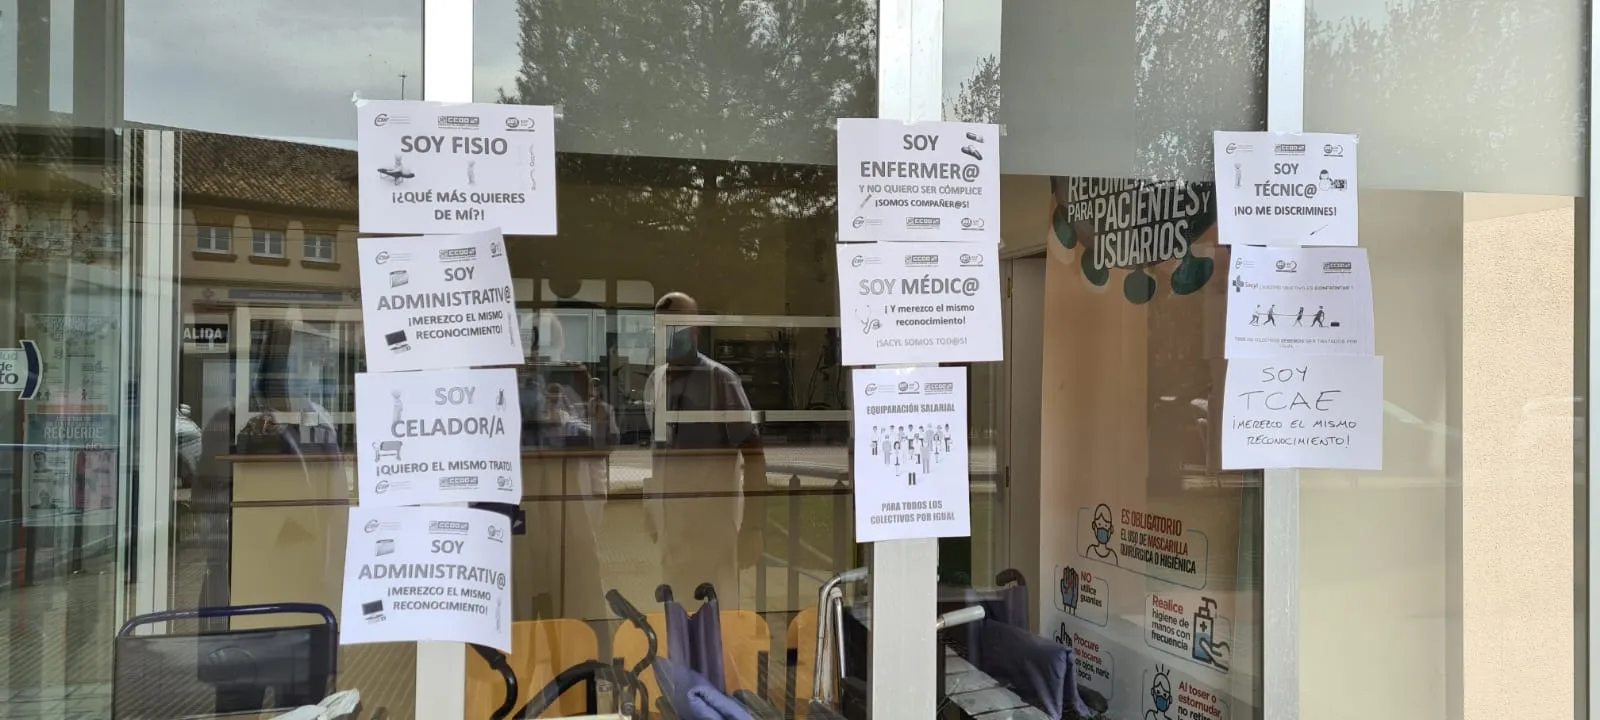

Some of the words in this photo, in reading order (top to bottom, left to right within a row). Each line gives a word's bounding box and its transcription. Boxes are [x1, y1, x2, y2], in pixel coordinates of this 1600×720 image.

[401, 135, 444, 153] SOY
[452, 136, 508, 154] FISIO
[903, 134, 939, 151] SOY
[860, 161, 980, 182] ENFERMER@
[1274, 163, 1299, 175] SOY
[859, 184, 865, 193] Y
[867, 185, 880, 193] NO
[884, 185, 919, 194] QUIERO
[921, 186, 937, 194] SER
[939, 184, 982, 195] CÓMPLICE
[1254, 180, 1317, 198] TÉCNIC@
[393, 190, 433, 204] ¡¿QUÉ
[437, 190, 467, 203] MÁS
[471, 193, 526, 205] QUIERES
[875, 199, 909, 208] ¡SOMOS
[910, 198, 970, 209] COMPAÑER@S!
[434, 209, 451, 221] DE
[455, 208, 485, 221] MÍ?!
[1068, 202, 1093, 223] PARA
[1094, 182, 1200, 232] PACIENTES
[1202, 190, 1211, 213] Y
[1234, 206, 1252, 216] ¡NO
[1256, 206, 1271, 215] ME
[1274, 206, 1337, 216] DISCRIMINES!
[1094, 219, 1189, 270] USUARIOS
[444, 266, 475, 282] SOY
[859, 279, 896, 295] SOY
[901, 274, 980, 296] MÉDIC@
[377, 285, 511, 311] ADMINISTRATIV@
[898, 305, 934, 313] merezco
[936, 303, 944, 312] el
[946, 304, 975, 312] mismo
[408, 314, 463, 327] ¡MEREZCO
[466, 313, 476, 323] EL
[478, 311, 503, 321] MISMO
[896, 316, 966, 326] reconocimiento!
[183, 327, 222, 339] ALIDA
[416, 326, 503, 340] RECONOCIMIENTO!
[904, 338, 934, 346] SOMOS
[1261, 366, 1308, 383] SOY
[435, 386, 476, 406] SOY
[1238, 390, 1342, 411] TCAE
[867, 402, 919, 415] EQUIPARACIÓN
[921, 403, 955, 413] SALARIAL
[391, 415, 505, 438] CELADOR/A
[1290, 419, 1304, 428] EL
[1313, 420, 1357, 429] MISMO
[44, 425, 105, 439] RECUERDE
[1247, 434, 1350, 448] RECONOCIMIENTO!
[376, 462, 429, 476] ¡QUIERO
[432, 461, 444, 471] EL
[449, 460, 487, 471] MISMO
[489, 460, 512, 471] TRATO!
[881, 502, 900, 512] PARA
[902, 501, 927, 511] TODOS
[929, 500, 942, 509] LOS
[870, 514, 915, 525] COLECTIVOS
[916, 514, 932, 522] POR
[933, 512, 955, 521] IGUAL
[1121, 508, 1130, 525] ES
[1131, 510, 1182, 536] OBLIGATORIO
[431, 539, 464, 554] SOY
[1121, 528, 1127, 541] EL
[1128, 529, 1138, 544] USO
[1139, 532, 1147, 546] DE
[1147, 535, 1188, 556] MASCARILLA
[1154, 551, 1160, 565] O
[1160, 554, 1196, 574] HIGIÉNICA
[358, 564, 506, 590] ADMINISTRATIV@
[1081, 571, 1092, 583] NO
[387, 587, 445, 598] ¡MEREZCO
[447, 587, 458, 596] EL
[460, 589, 492, 601] MISMO
[1081, 584, 1096, 596] utilice
[393, 601, 488, 615] RECONOCIMIENTO!
[1152, 595, 1184, 614] Realice
[1152, 608, 1177, 625] higiene
[1179, 618, 1190, 628] de
[1151, 621, 1174, 635] manos
[1176, 630, 1191, 640] con
[1073, 632, 1100, 652] Procure
[1151, 630, 1189, 650] frecuencia
[1081, 650, 1103, 665] tocarse
[1078, 670, 1092, 681] boca
[1095, 667, 1110, 679] nariz
[1178, 680, 1187, 692] Al
[1189, 684, 1210, 700] toser
[1211, 695, 1217, 703] o
[1178, 705, 1188, 716] no
